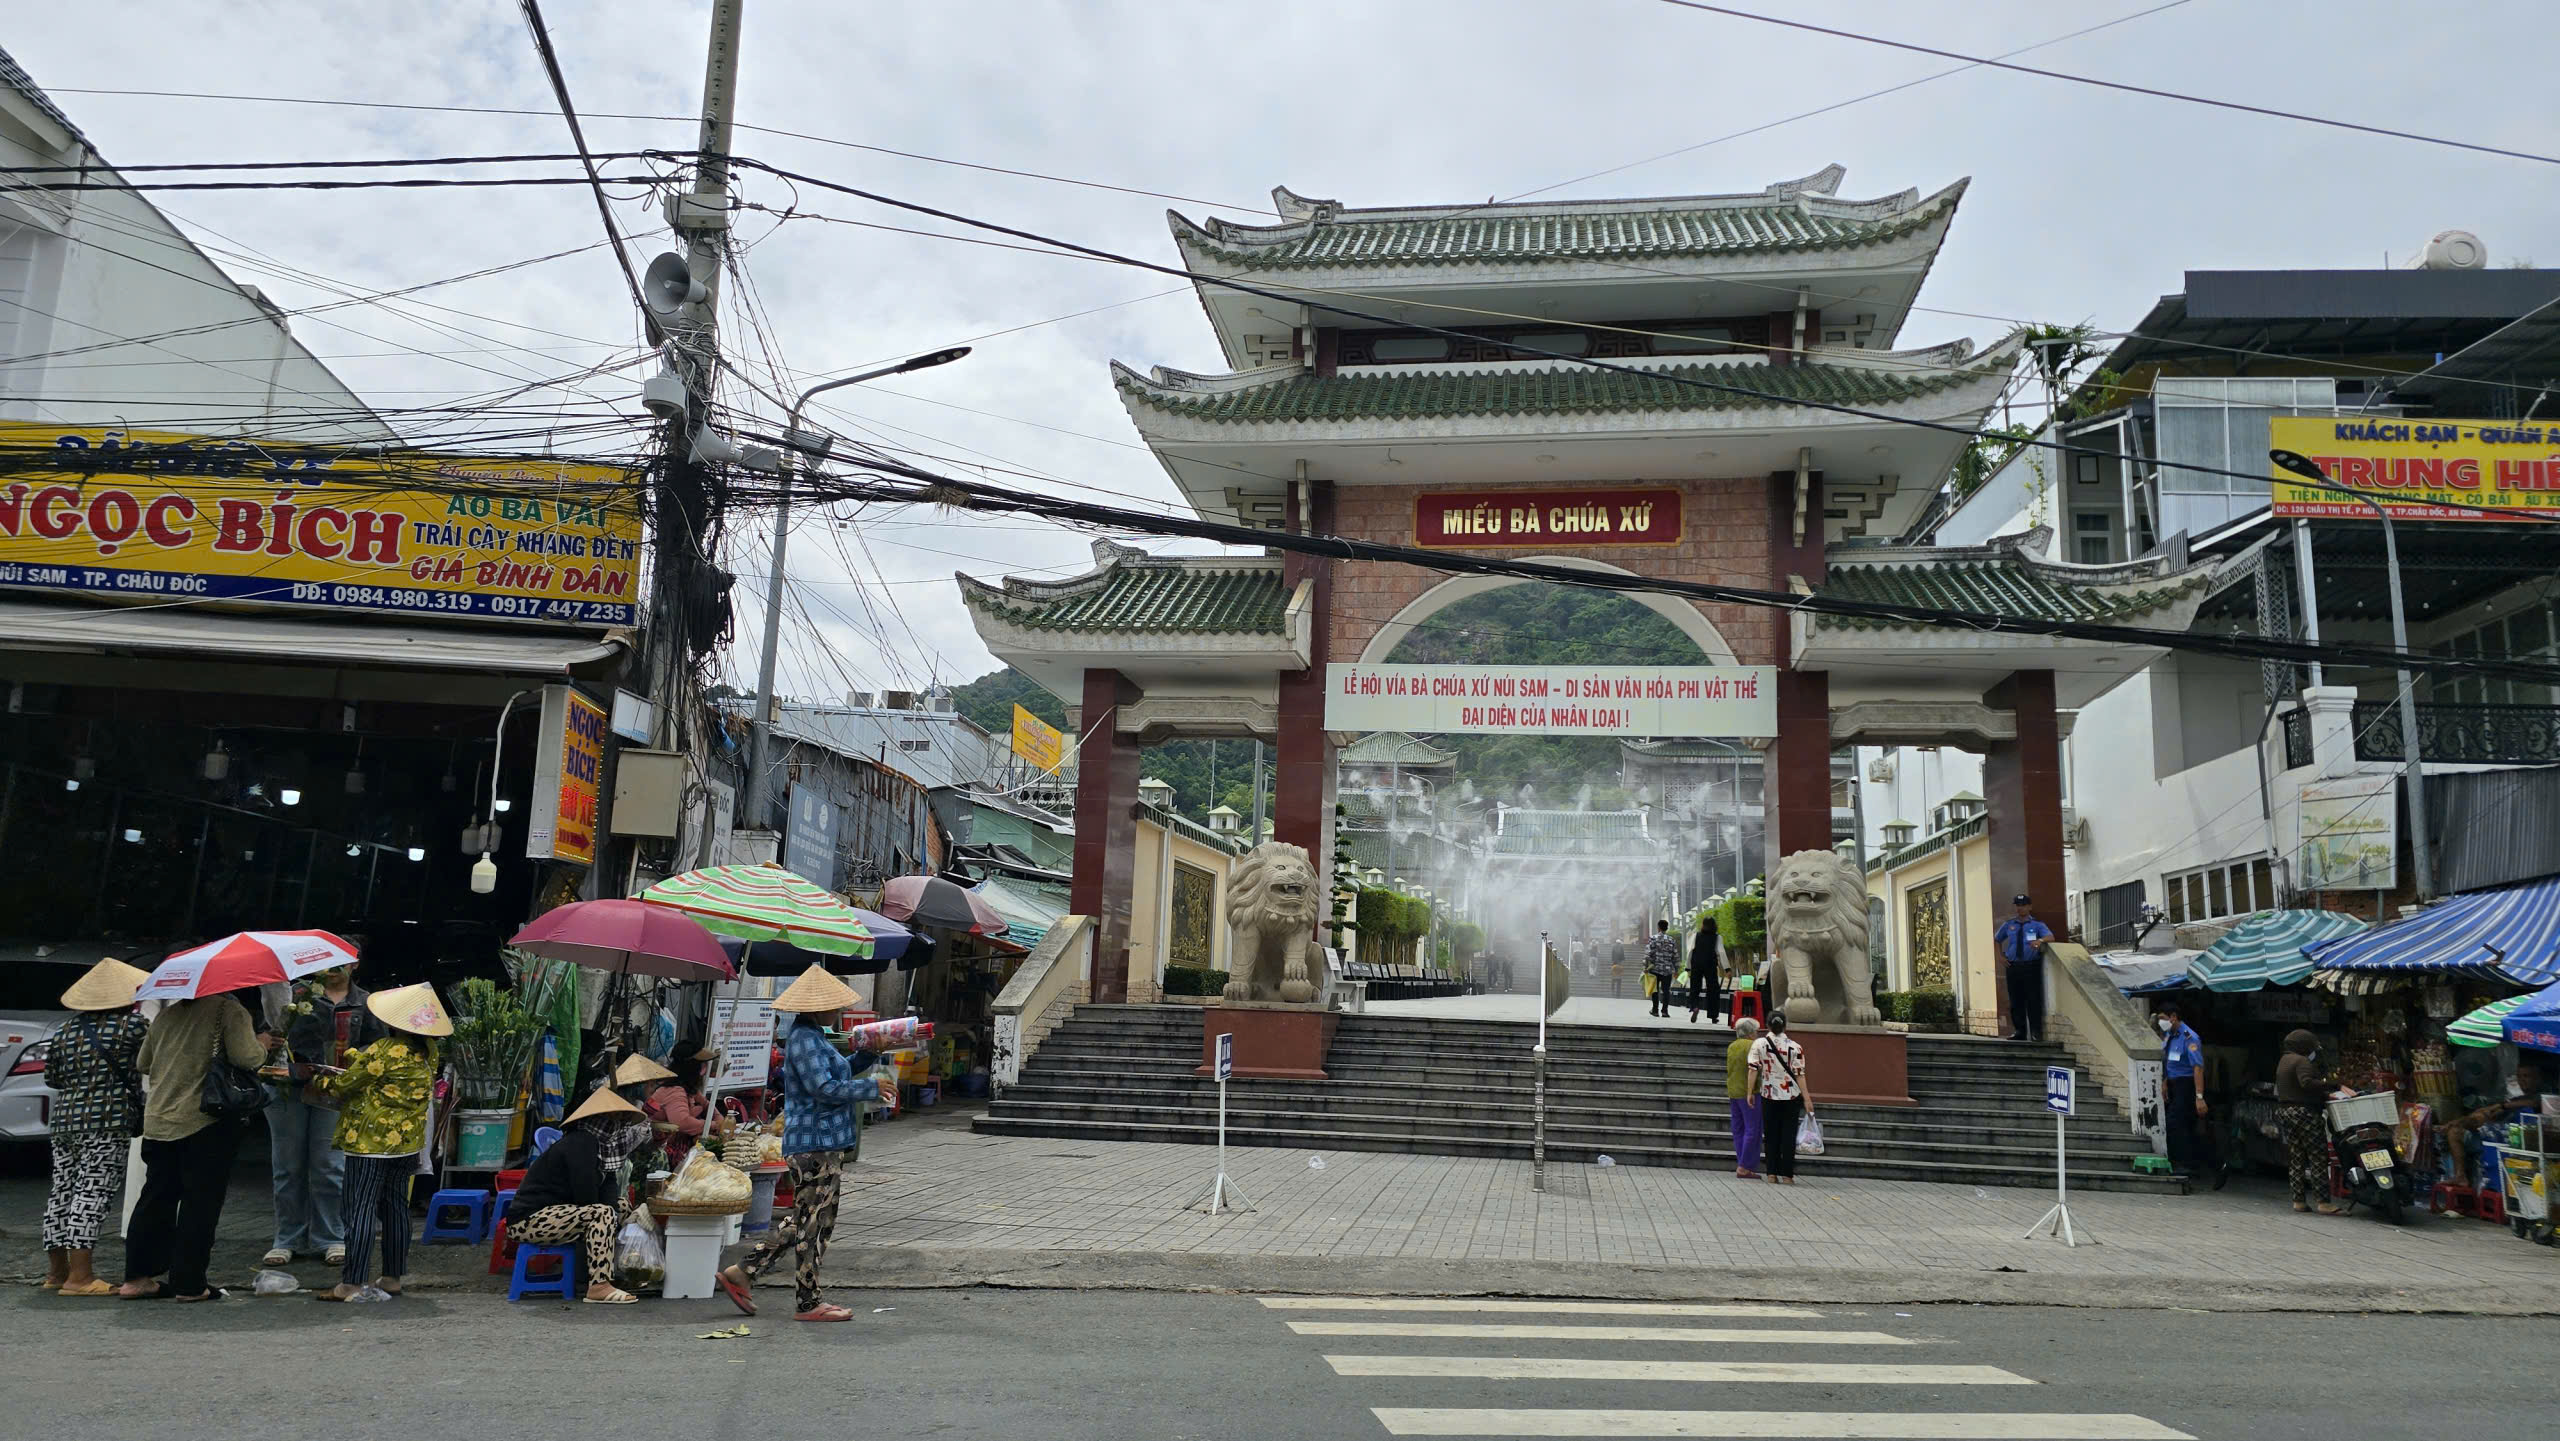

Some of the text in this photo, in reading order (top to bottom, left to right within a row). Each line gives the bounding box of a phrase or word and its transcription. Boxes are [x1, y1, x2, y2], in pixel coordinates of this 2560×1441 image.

[2335, 419, 2410, 442] KHÁCH
[2414, 423, 2458, 449] SẠN
[2480, 421, 2542, 444] QUÁN
[2311, 456, 2481, 489] TRUNG
[0, 484, 406, 565] NGỌC BÍCH
[1442, 499, 1653, 535] MIẾU BÀ CHÚA XỨ
[413, 519, 634, 561] TRÁI CÂY NHANG ĐÈN
[27, 567, 67, 585] SAM
[84, 571, 111, 588] TP.
[116, 573, 165, 591] CHÂU
[169, 573, 208, 593] ĐỐC
[292, 582, 328, 602] DĐ:
[333, 585, 473, 611] 0984.980.319
[410, 552, 629, 596] GIÁ BÌNH DÂN
[1344, 668, 1357, 695] LỄ
[1360, 673, 1382, 699] HỘI
[1386, 672, 1407, 696] VÍA
[1411, 672, 1428, 696] BÀ
[1432, 674, 1467, 697] CHÚA
[1471, 673, 1490, 697] XỨ
[1493, 674, 1515, 697] NÚI
[1519, 679, 1549, 698] SAM
[1565, 679, 1579, 698] DI
[1583, 674, 1610, 699] SẢN
[1615, 675, 1642, 699] VĂN
[1646, 675, 1674, 699] HÓA
[1678, 679, 1700, 699] PHI
[1704, 675, 1729, 703] VẬT
[1733, 671, 1759, 699] THỂ
[568, 701, 604, 749] NGỌC
[1462, 702, 1630, 732] ĐẠI DIỆN CỦA NHÂN LOẠI !
[566, 739, 597, 785] BÍCH
